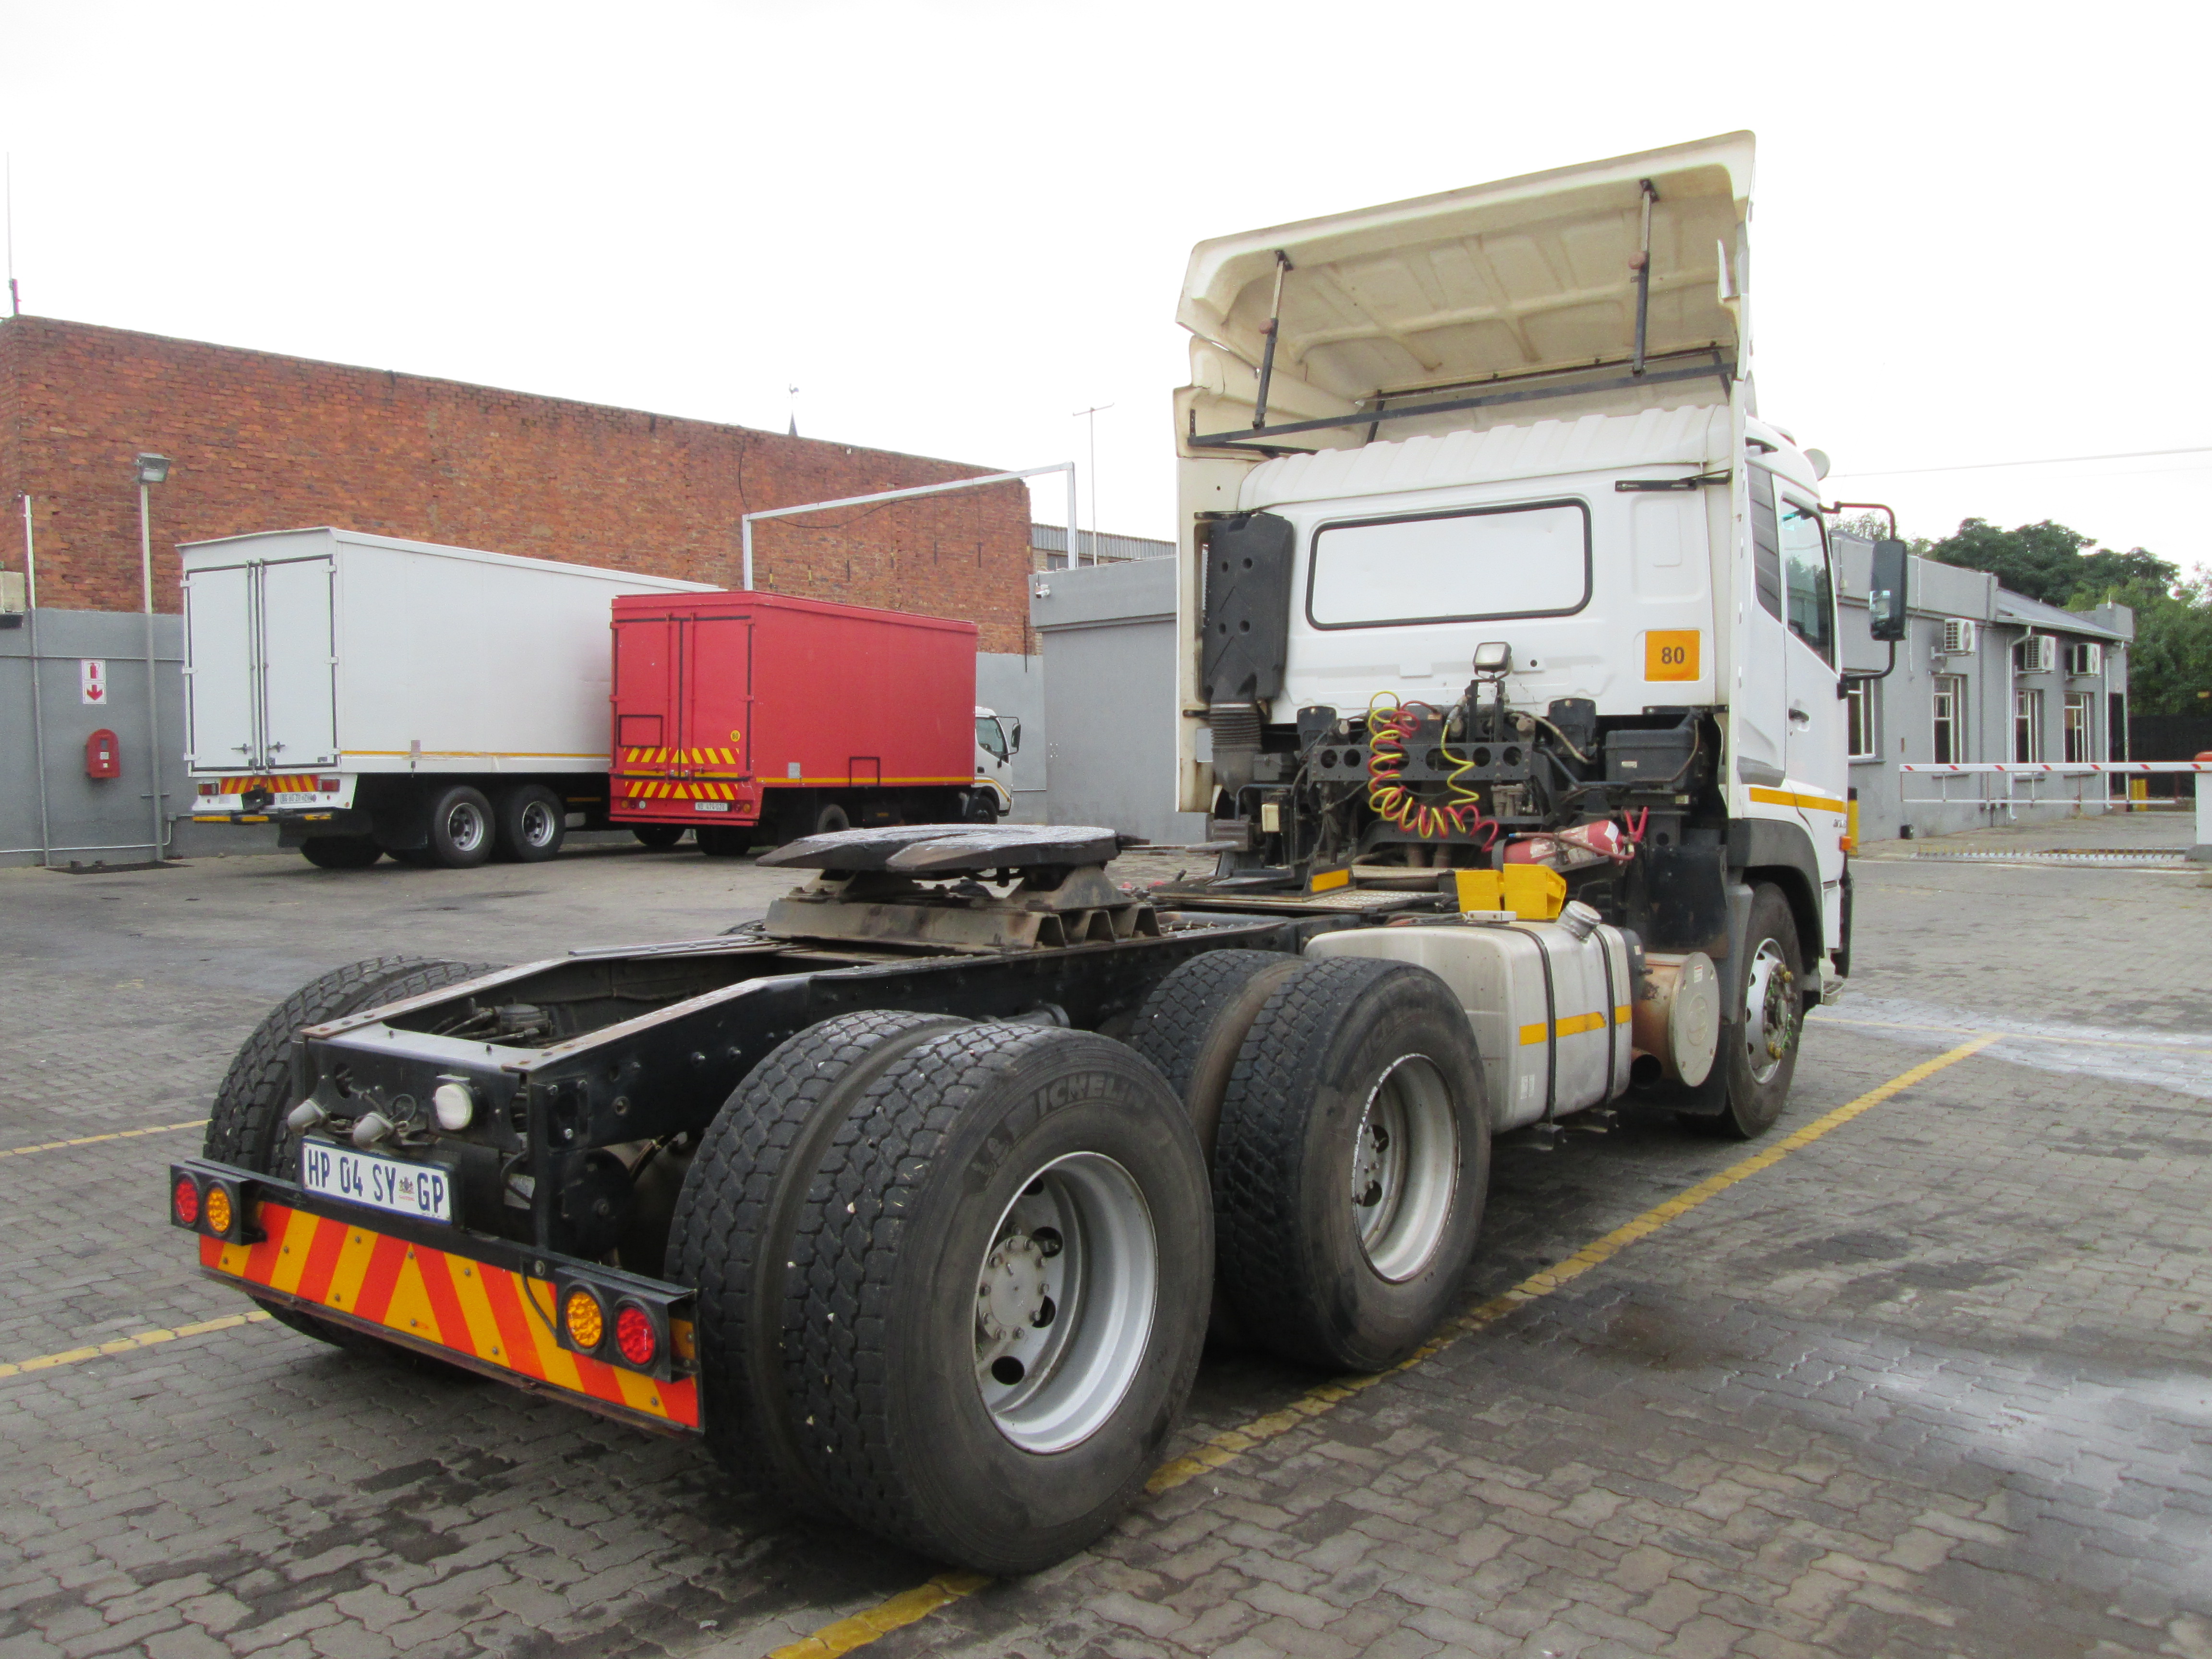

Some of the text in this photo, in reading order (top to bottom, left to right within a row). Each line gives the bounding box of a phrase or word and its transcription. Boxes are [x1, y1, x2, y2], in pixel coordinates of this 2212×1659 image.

[1661, 646, 1684, 664] 80
[308, 1149, 444, 1213] HP 04 SY GP
